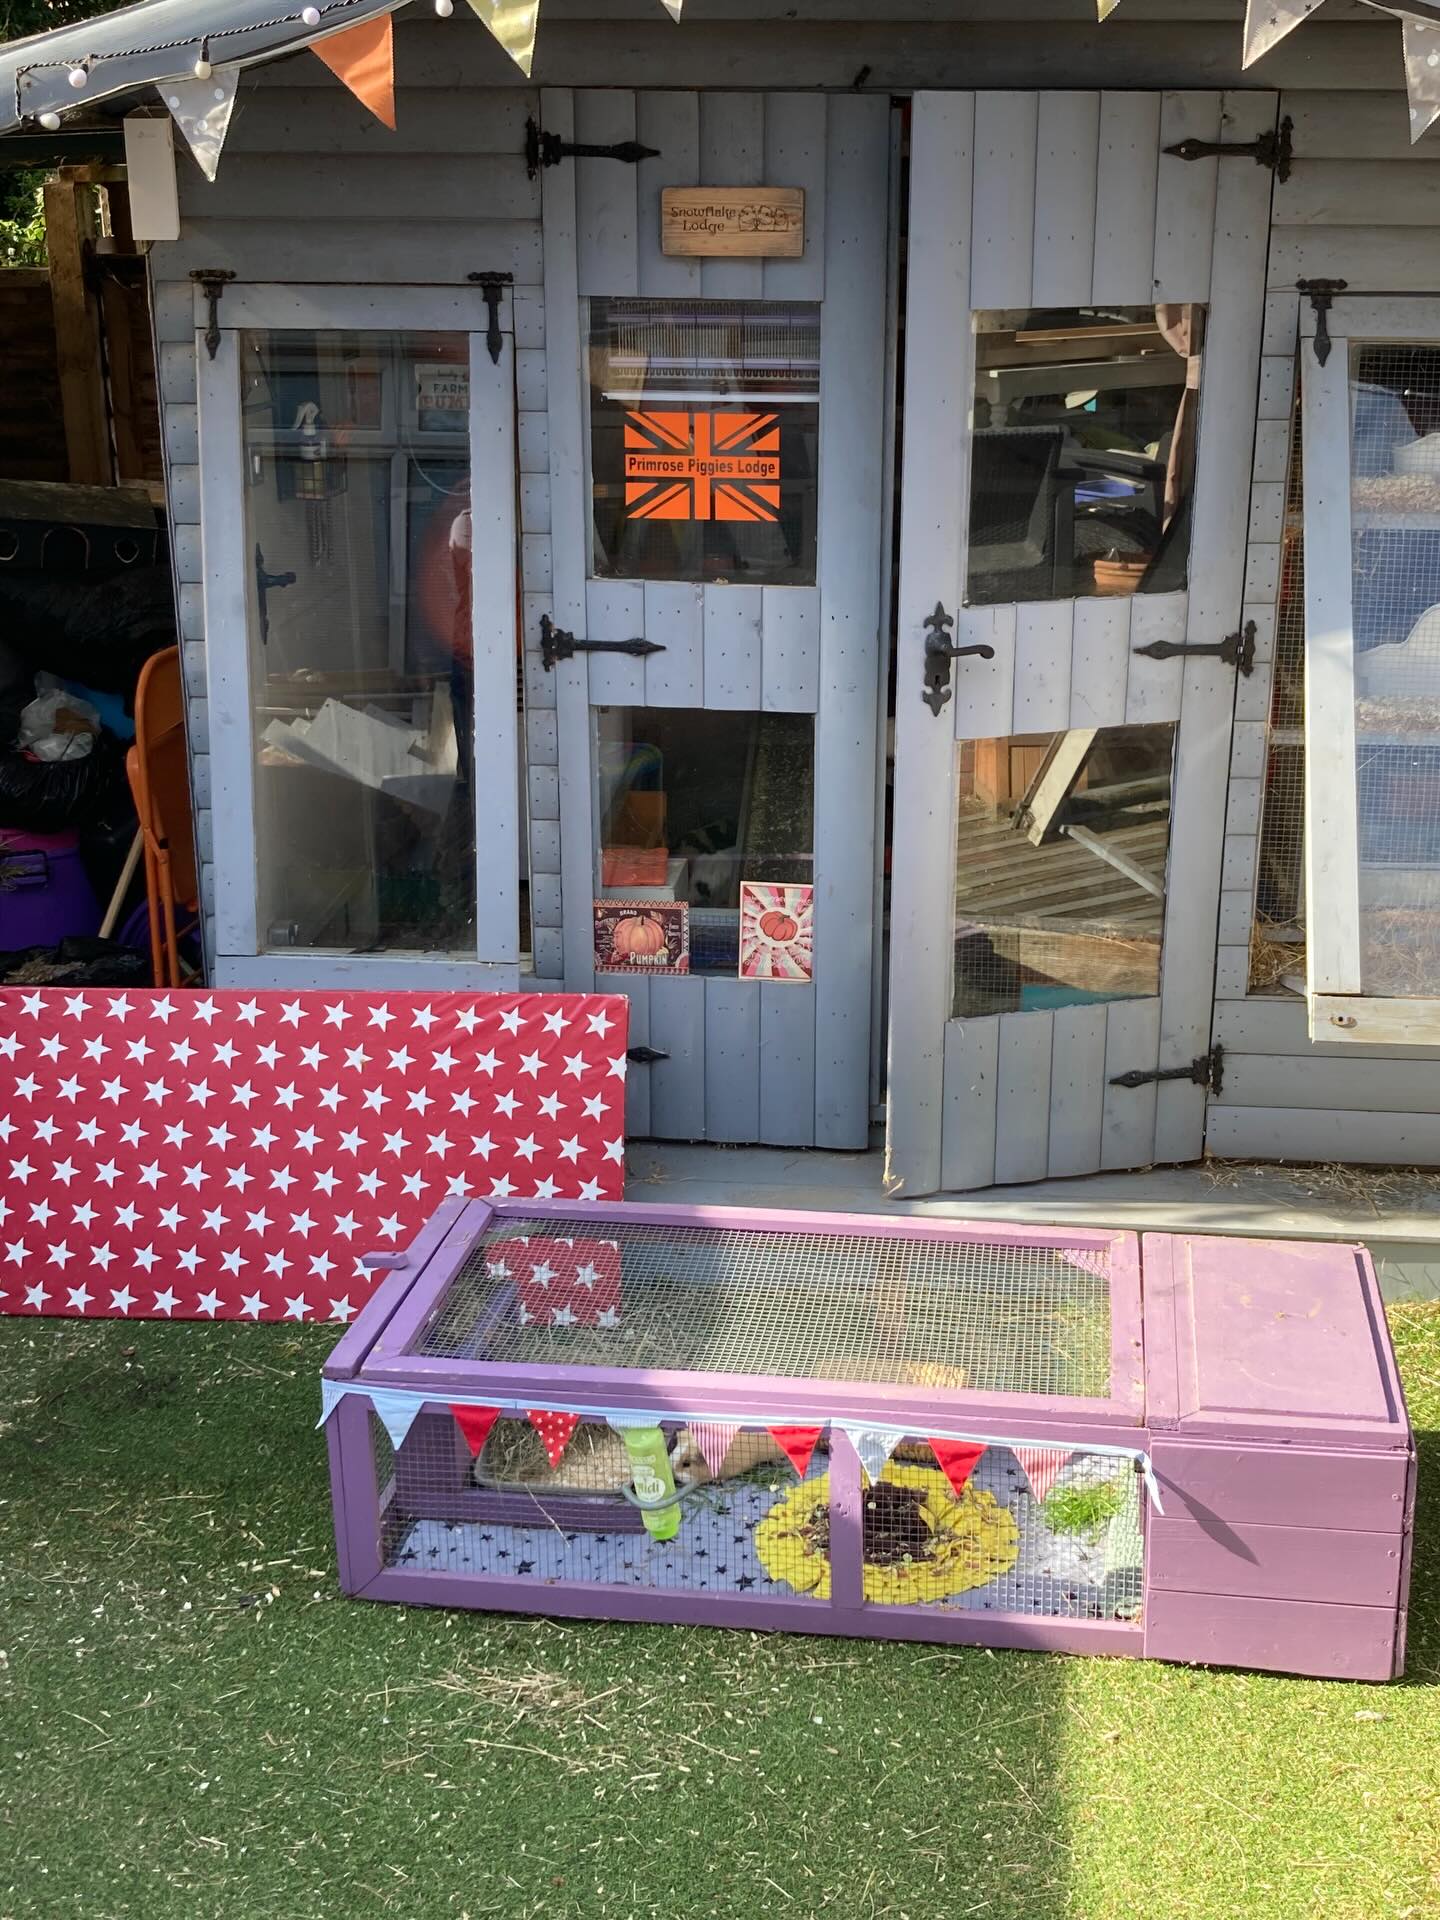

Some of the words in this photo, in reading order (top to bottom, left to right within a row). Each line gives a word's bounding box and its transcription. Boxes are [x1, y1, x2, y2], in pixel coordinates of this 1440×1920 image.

[683, 219, 725, 233] Lodge
[433, 383, 468, 394] FARM
[629, 457, 684, 472] Primrose
[688, 459, 733, 476] Piggies
[737, 460, 775, 476] Lodge
